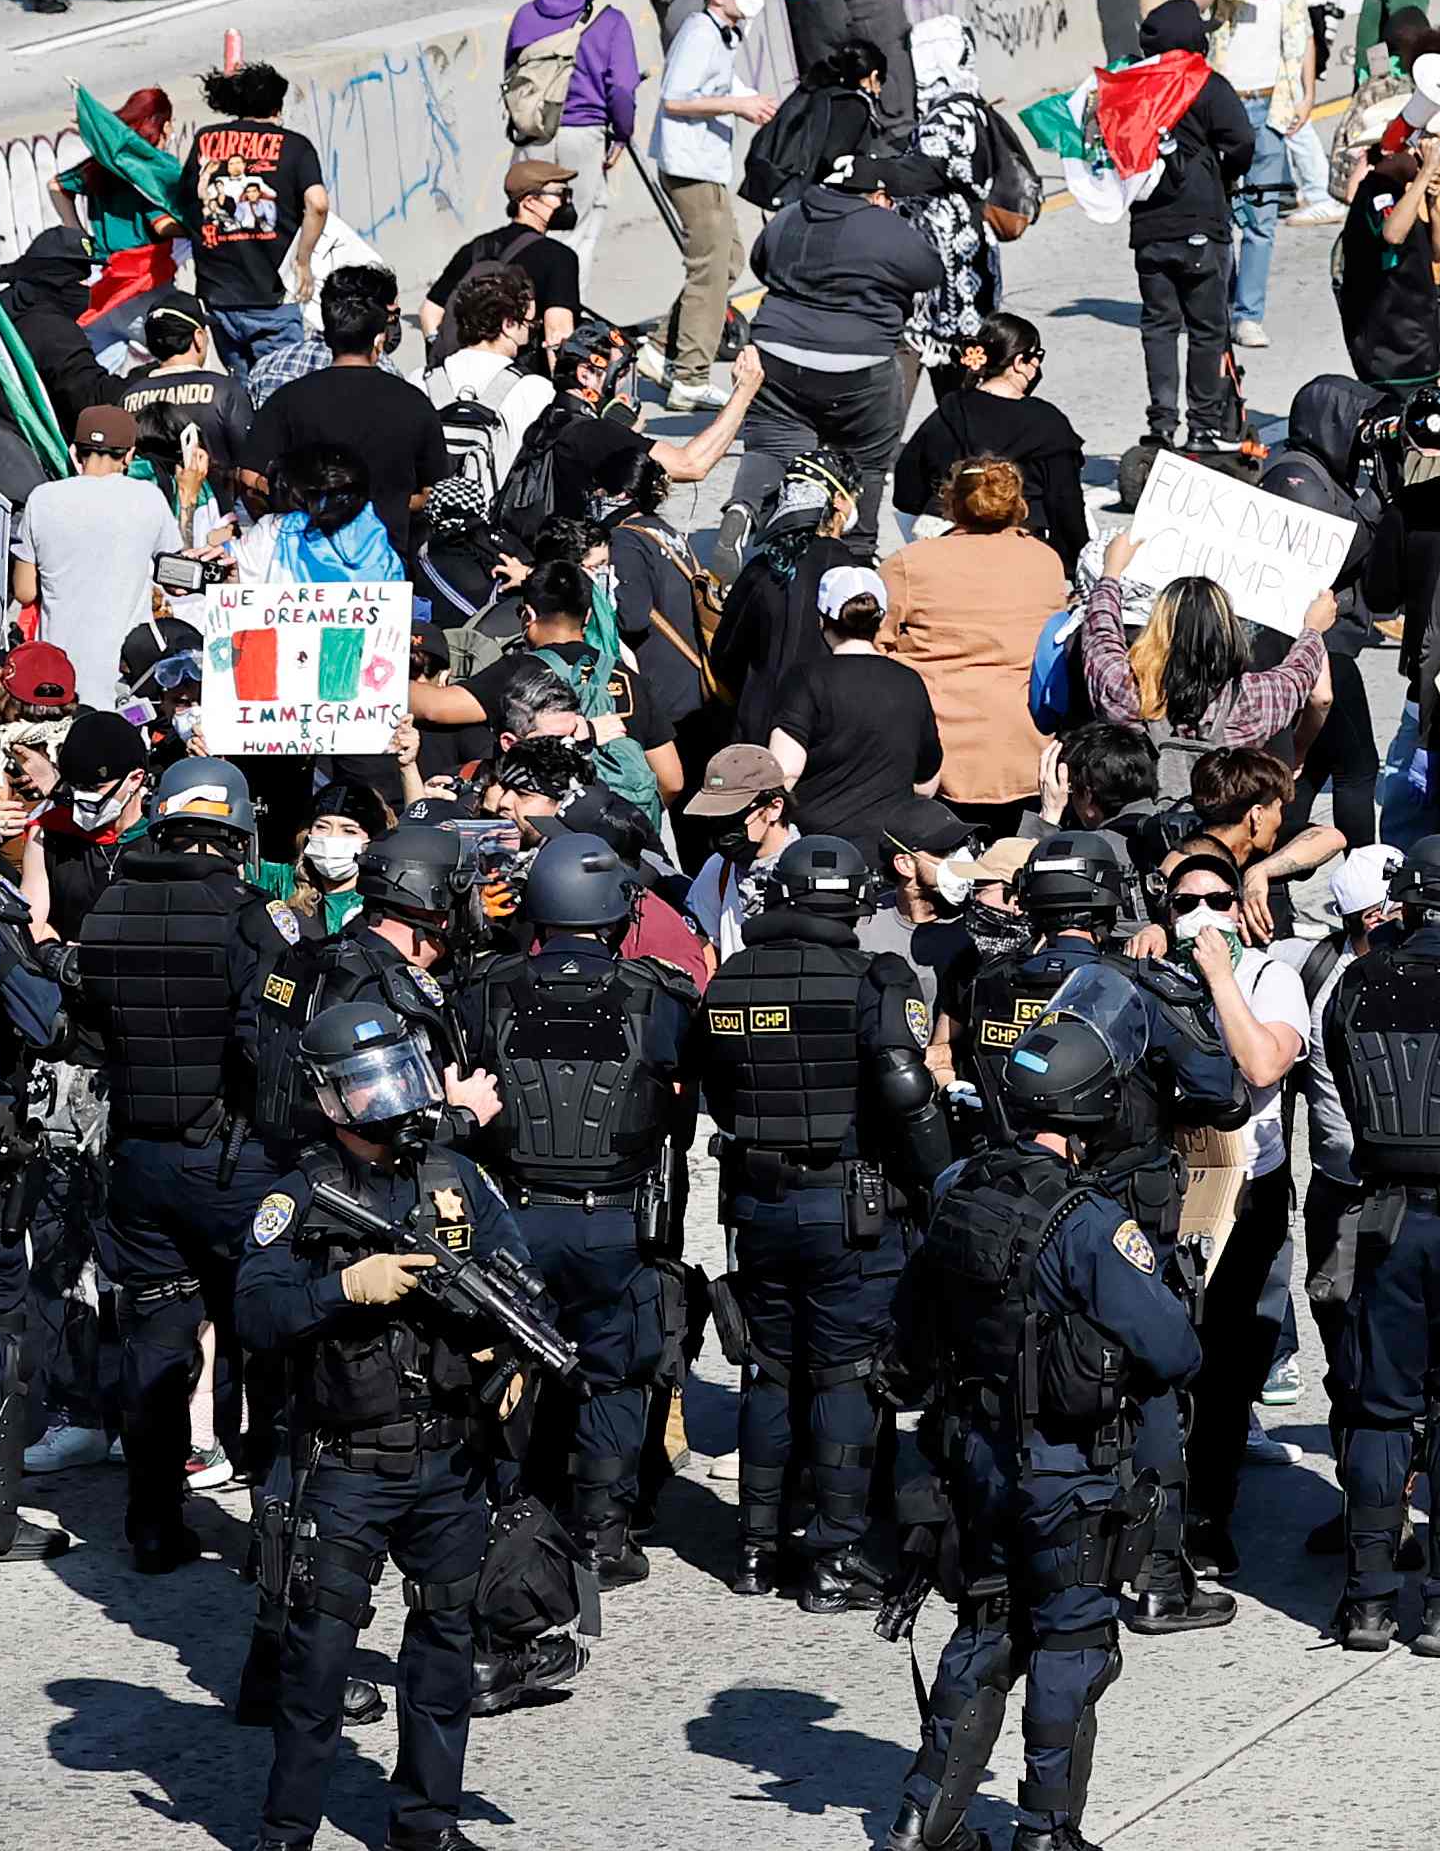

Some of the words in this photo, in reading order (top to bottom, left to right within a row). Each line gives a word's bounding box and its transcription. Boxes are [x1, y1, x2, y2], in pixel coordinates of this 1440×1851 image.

[198, 131, 285, 162] SCARFACE
[1150, 461, 1230, 528] FUCK
[1238, 499, 1345, 568] DONALD
[220, 590, 255, 612] WE
[277, 587, 326, 608] ARE
[348, 587, 391, 604] ALL
[264, 606, 380, 628] DREAMERS
[237, 704, 404, 730] IMMIGRANTS
[243, 730, 336, 753] HUMANS!
[301, 723, 311, 739] &
[713, 1013, 739, 1031] SOU
[754, 1010, 785, 1029] CHP
[1020, 1005, 1043, 1021] SO
[986, 1027, 1019, 1044] CHP
